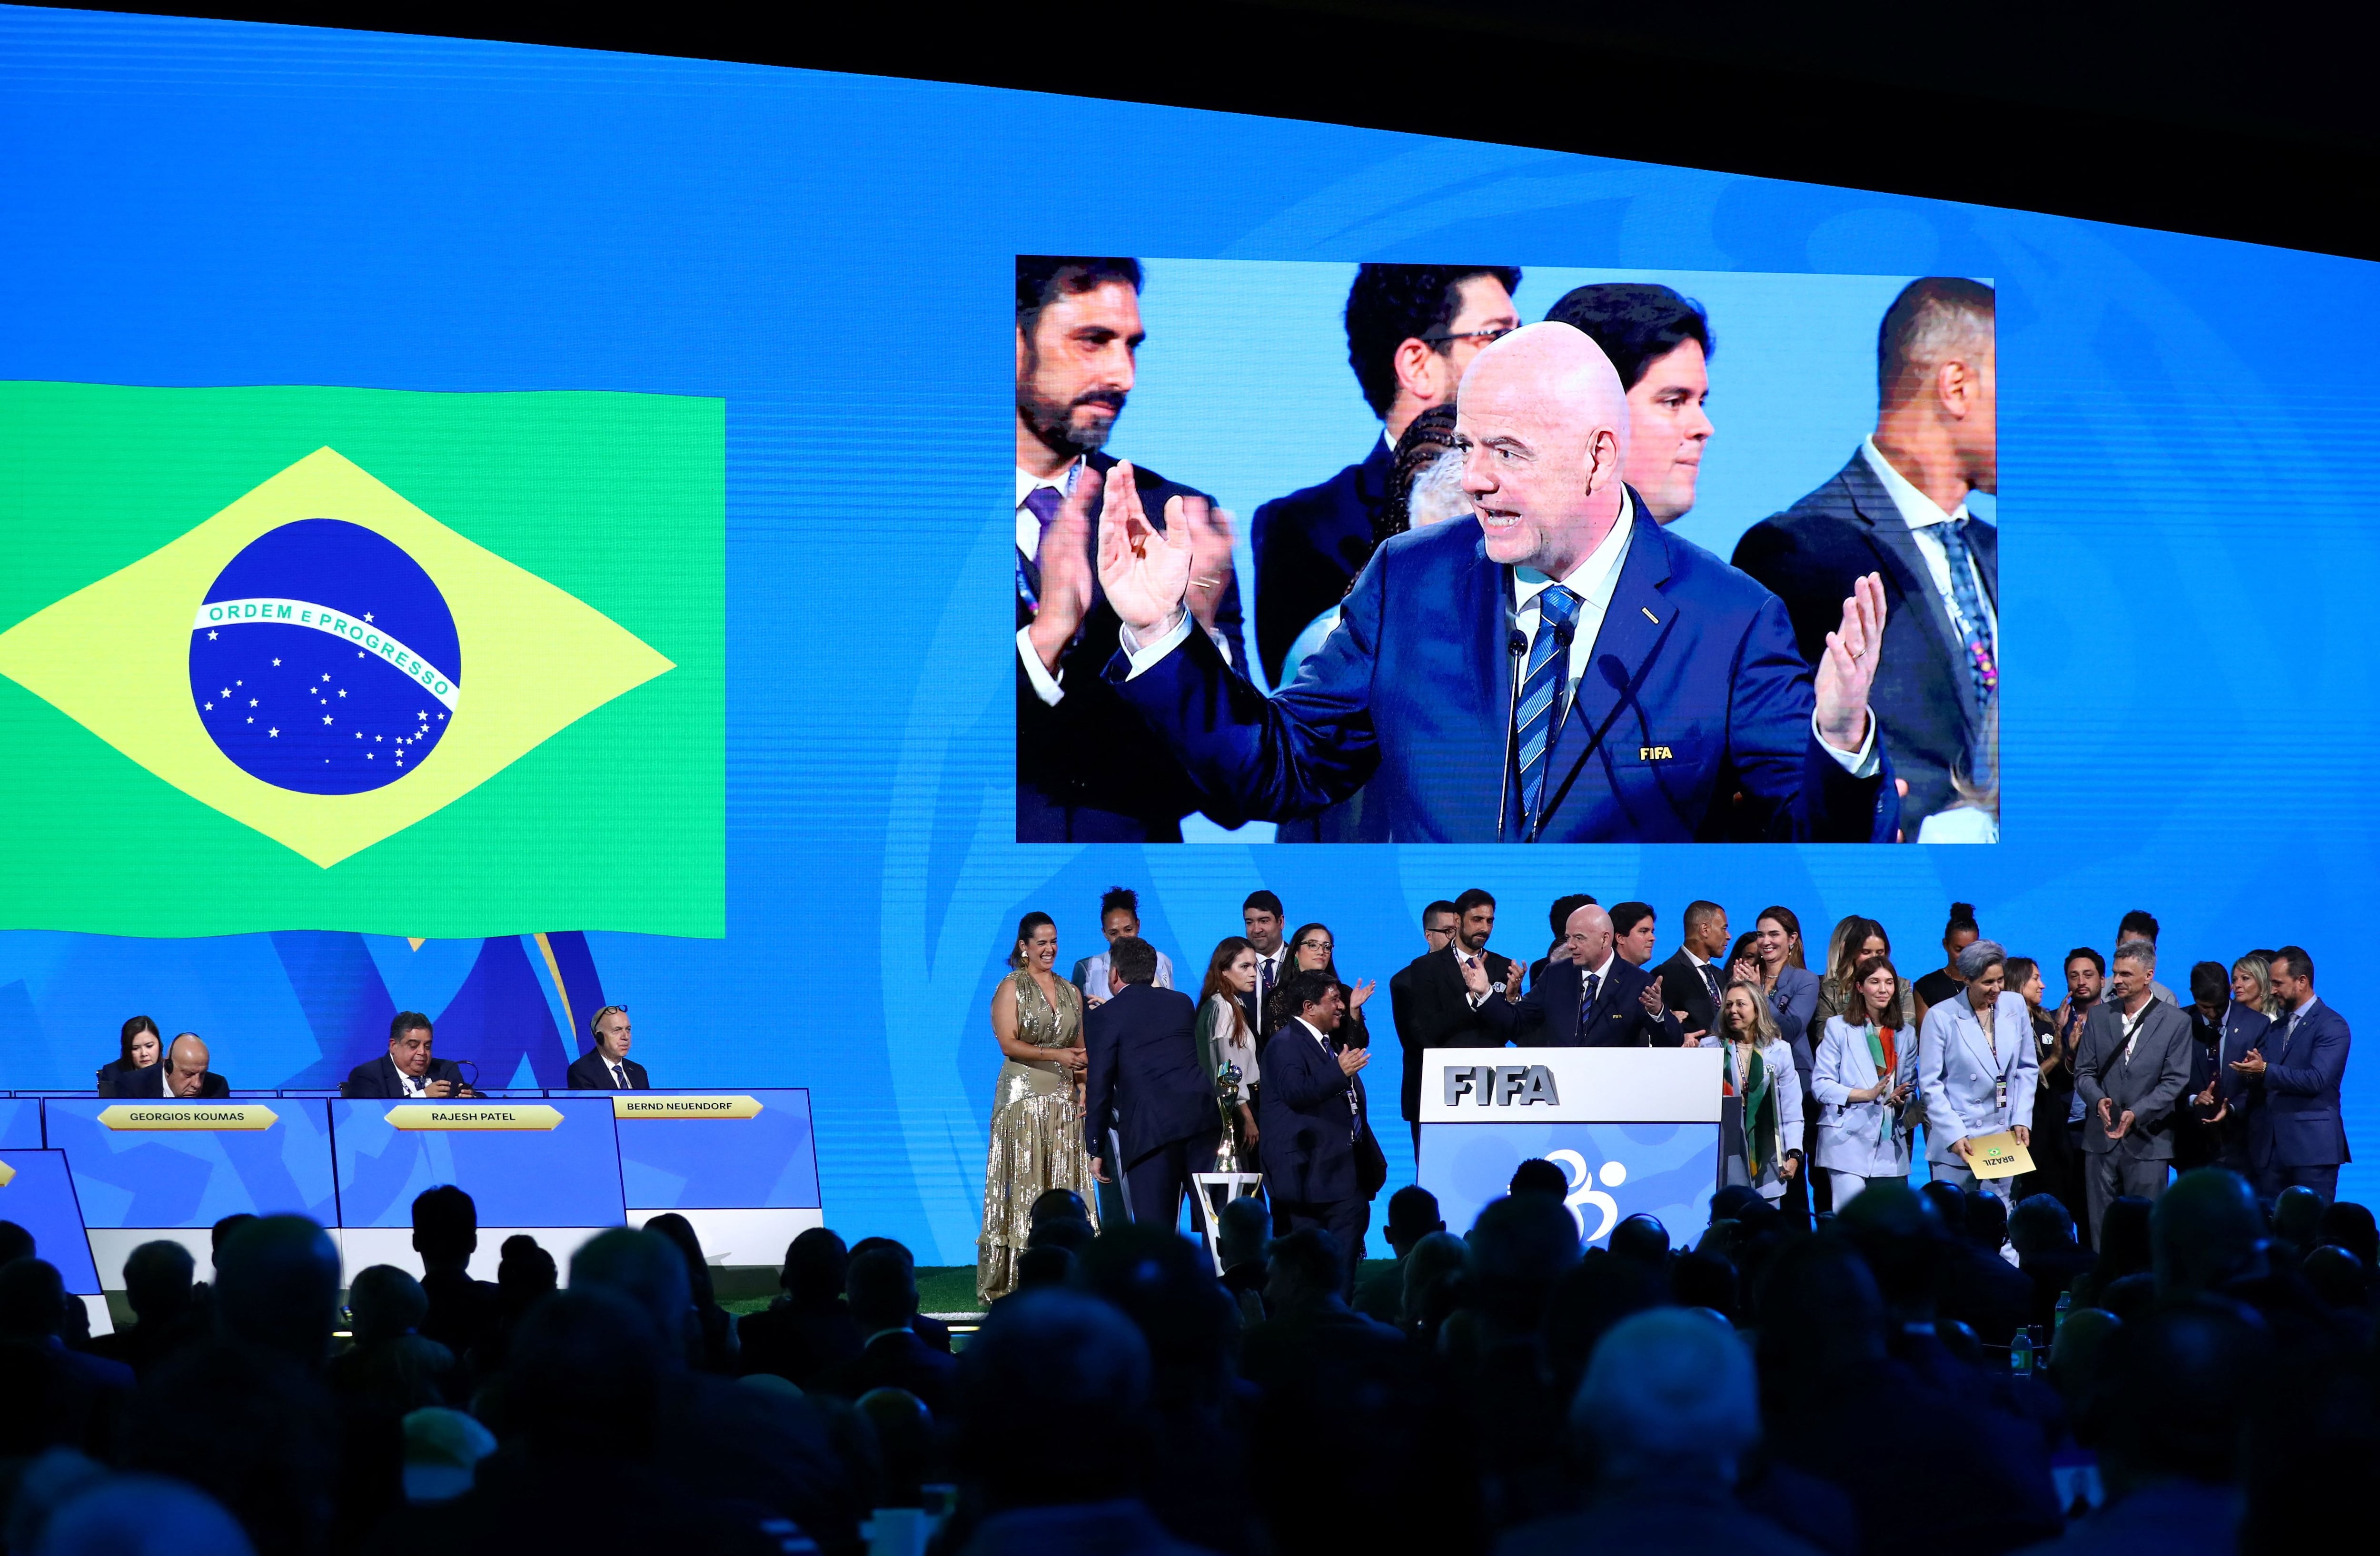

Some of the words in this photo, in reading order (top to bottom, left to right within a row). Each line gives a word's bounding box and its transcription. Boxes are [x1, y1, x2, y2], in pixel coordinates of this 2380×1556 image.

[209, 604, 292, 621] ORDEM
[301, 611, 312, 622] E
[319, 614, 448, 695] PROGRESSO
[1640, 747, 1673, 760] FIFA
[1444, 1065, 1560, 1107] FIFA
[1983, 1155, 2014, 1166] BRAZIL
